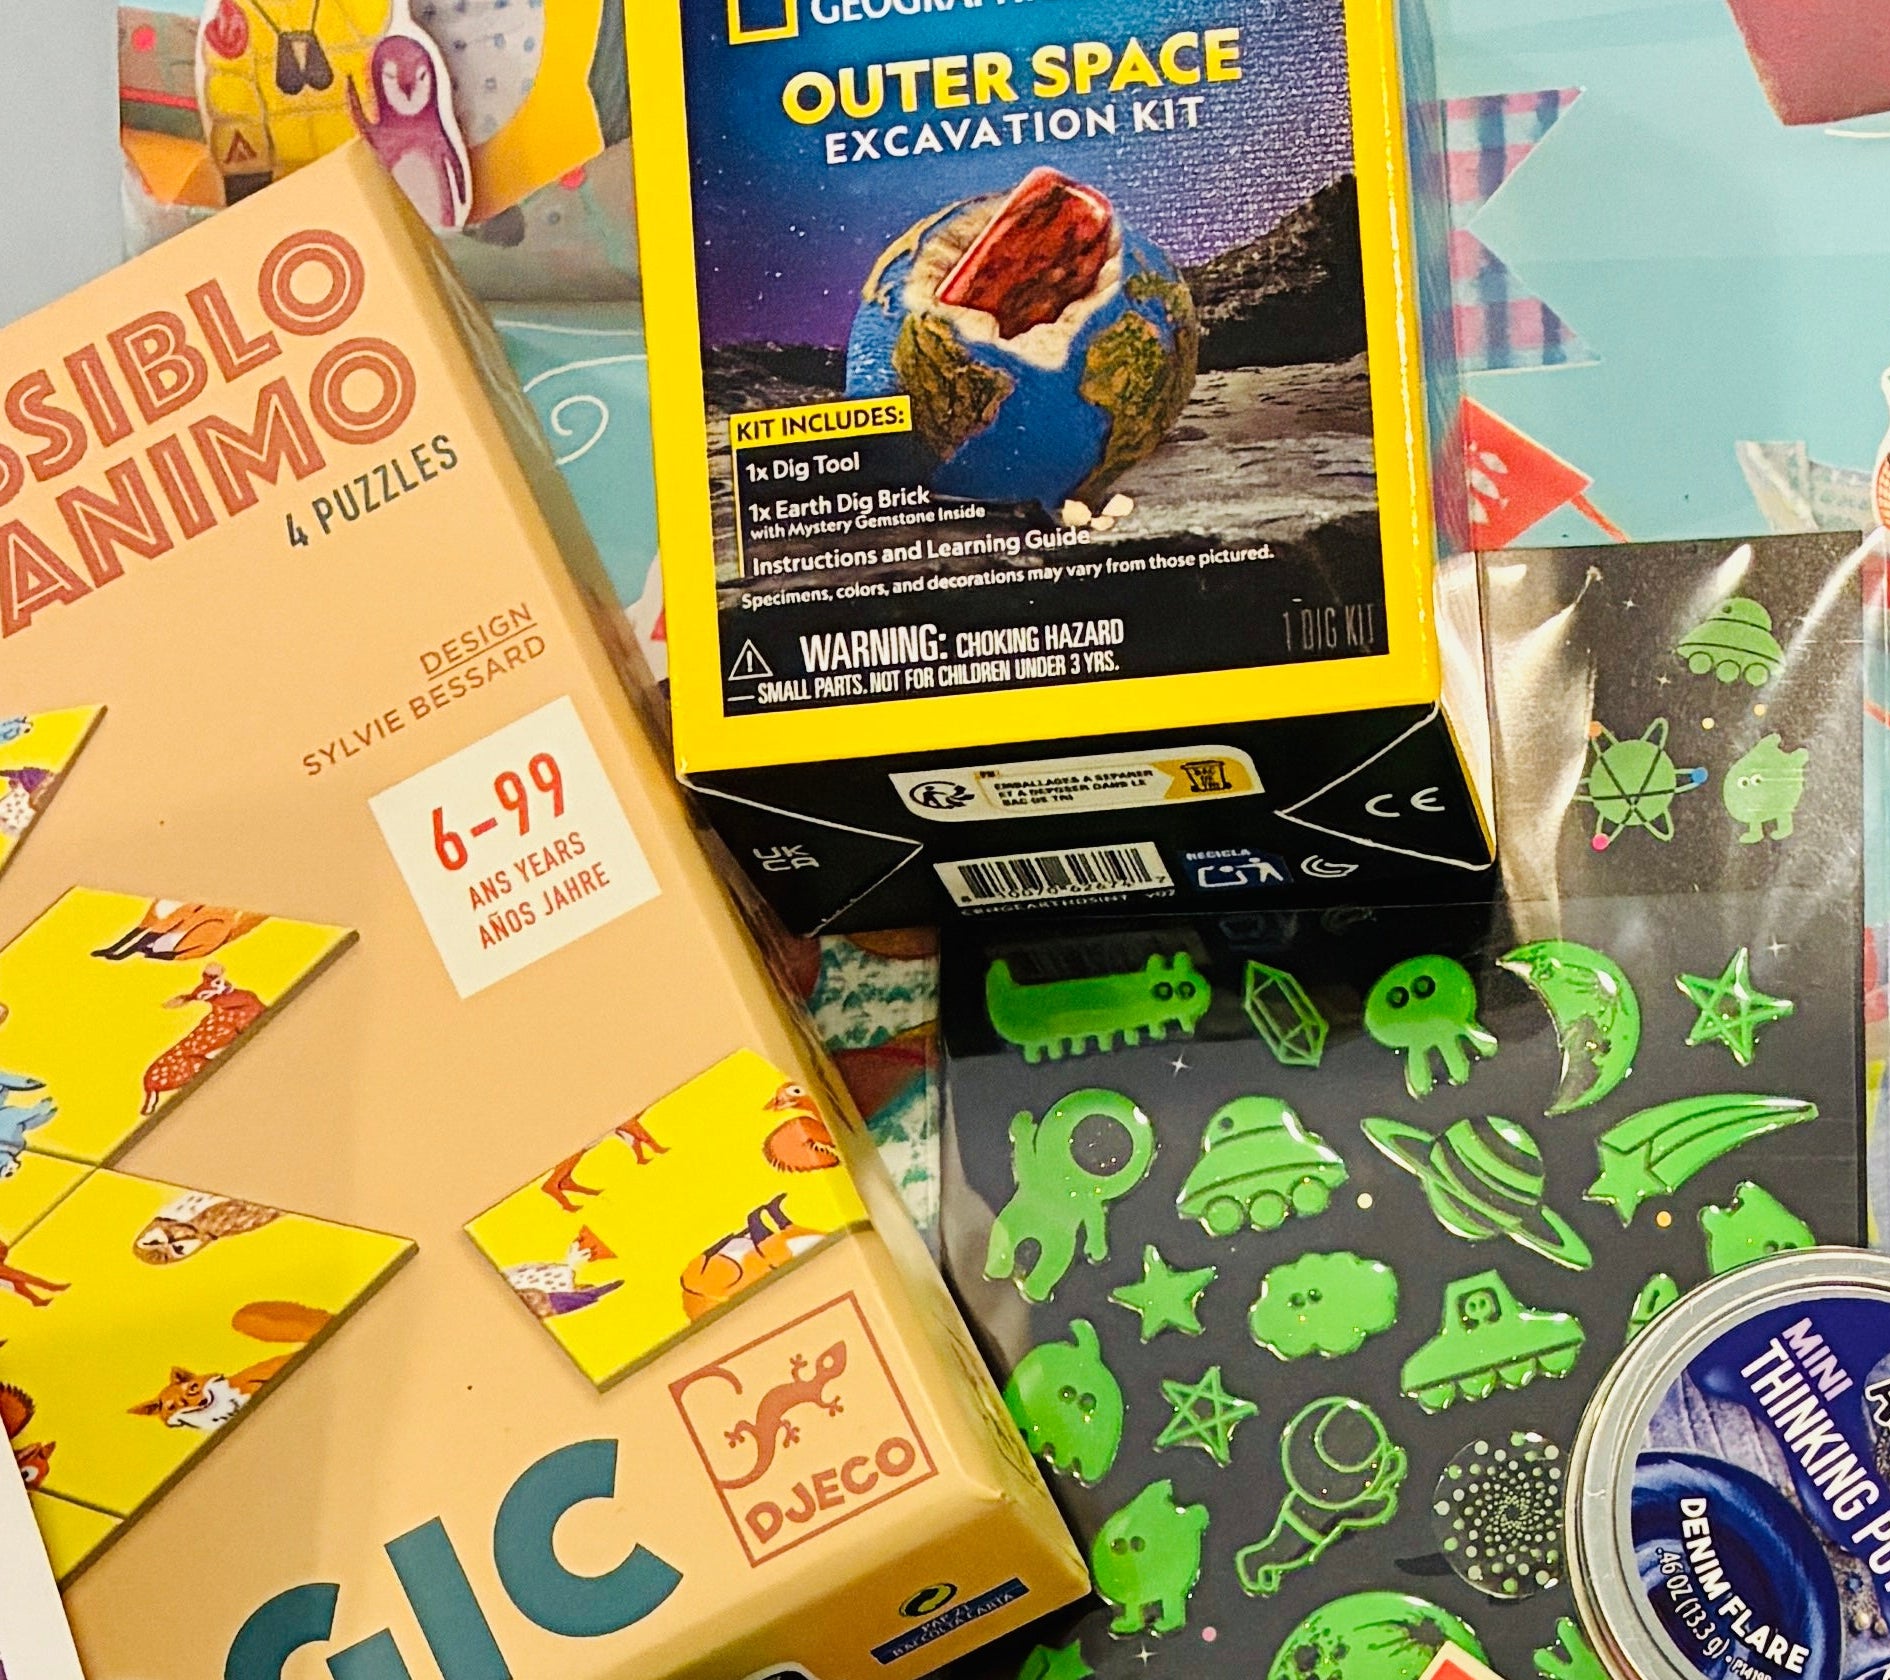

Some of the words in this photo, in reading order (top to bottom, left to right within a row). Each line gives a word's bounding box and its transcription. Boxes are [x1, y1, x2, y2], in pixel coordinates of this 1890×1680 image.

[782, 51, 1017, 127] OUTER
[1031, 26, 1243, 100] SPACE
[825, 104, 1128, 166] EXCAVATION
[1132, 95, 1205, 133] KIT
[0, 228, 366, 507] SIBLO
[737, 418, 777, 442] KIT
[781, 405, 905, 436] INCLUDES:
[0, 336, 417, 639] ANIMO
[286, 513, 309, 548] 4
[312, 433, 459, 535] PUZZLES
[746, 463, 769, 483] 1x
[773, 458, 810, 482] Dig
[813, 451, 861, 475] Tool
[748, 503, 771, 524] 1x
[776, 495, 832, 520] Earth
[836, 492, 874, 515] Dig
[878, 485, 930, 509] Brick
[750, 523, 786, 541] with
[788, 517, 853, 538] Mystery
[855, 511, 936, 530] Gemstone
[938, 504, 987, 522] Inside
[741, 587, 834, 612] Specimens,
[836, 580, 890, 602] colors,
[892, 575, 925, 593] and
[926, 567, 1026, 590] decorations
[1028, 565, 1061, 585] may
[1066, 561, 1104, 582] vary
[1106, 555, 1147, 575] from
[1149, 551, 1197, 571] those
[1199, 544, 1276, 569] pictured.
[752, 548, 878, 578] Instructions
[881, 540, 922, 565] and
[926, 533, 1022, 563] Learning
[1025, 526, 1092, 551] Guide
[419, 602, 534, 677] DESIGN
[799, 622, 948, 673] WARNING:
[955, 626, 1041, 660] CHOKING
[1045, 617, 1125, 648] HAZARD
[1301, 606, 1338, 651] DIG
[1344, 603, 1376, 647] KIT
[302, 722, 408, 778] SYLVIE
[408, 634, 547, 725] BESSARD
[757, 679, 812, 705] SMALL
[814, 671, 868, 700] PARTS.
[869, 667, 902, 694] NOT
[904, 667, 936, 690] FOR
[938, 658, 1012, 687] CHILDREN
[1014, 655, 1067, 679] UNDER
[1070, 653, 1082, 675] 3
[1084, 649, 1121, 672] YRS.
[430, 750, 567, 873] 6-99
[468, 869, 514, 911] ANS
[515, 832, 587, 886] YEARS
[477, 900, 540, 950] AÑOS
[540, 863, 611, 914] JAHRE
[1781, 1317, 1855, 1401] MINI
[1740, 1338, 1880, 1522] THINKING
[746, 1435, 918, 1546] DJECO
[1665, 1576, 1690, 1604] OZ
[1673, 1597, 1708, 1641] (13.3
[1680, 1497, 1734, 1601] DENIM
[1718, 1592, 1812, 1674] FLARE
[1704, 1634, 1731, 1661] g)
